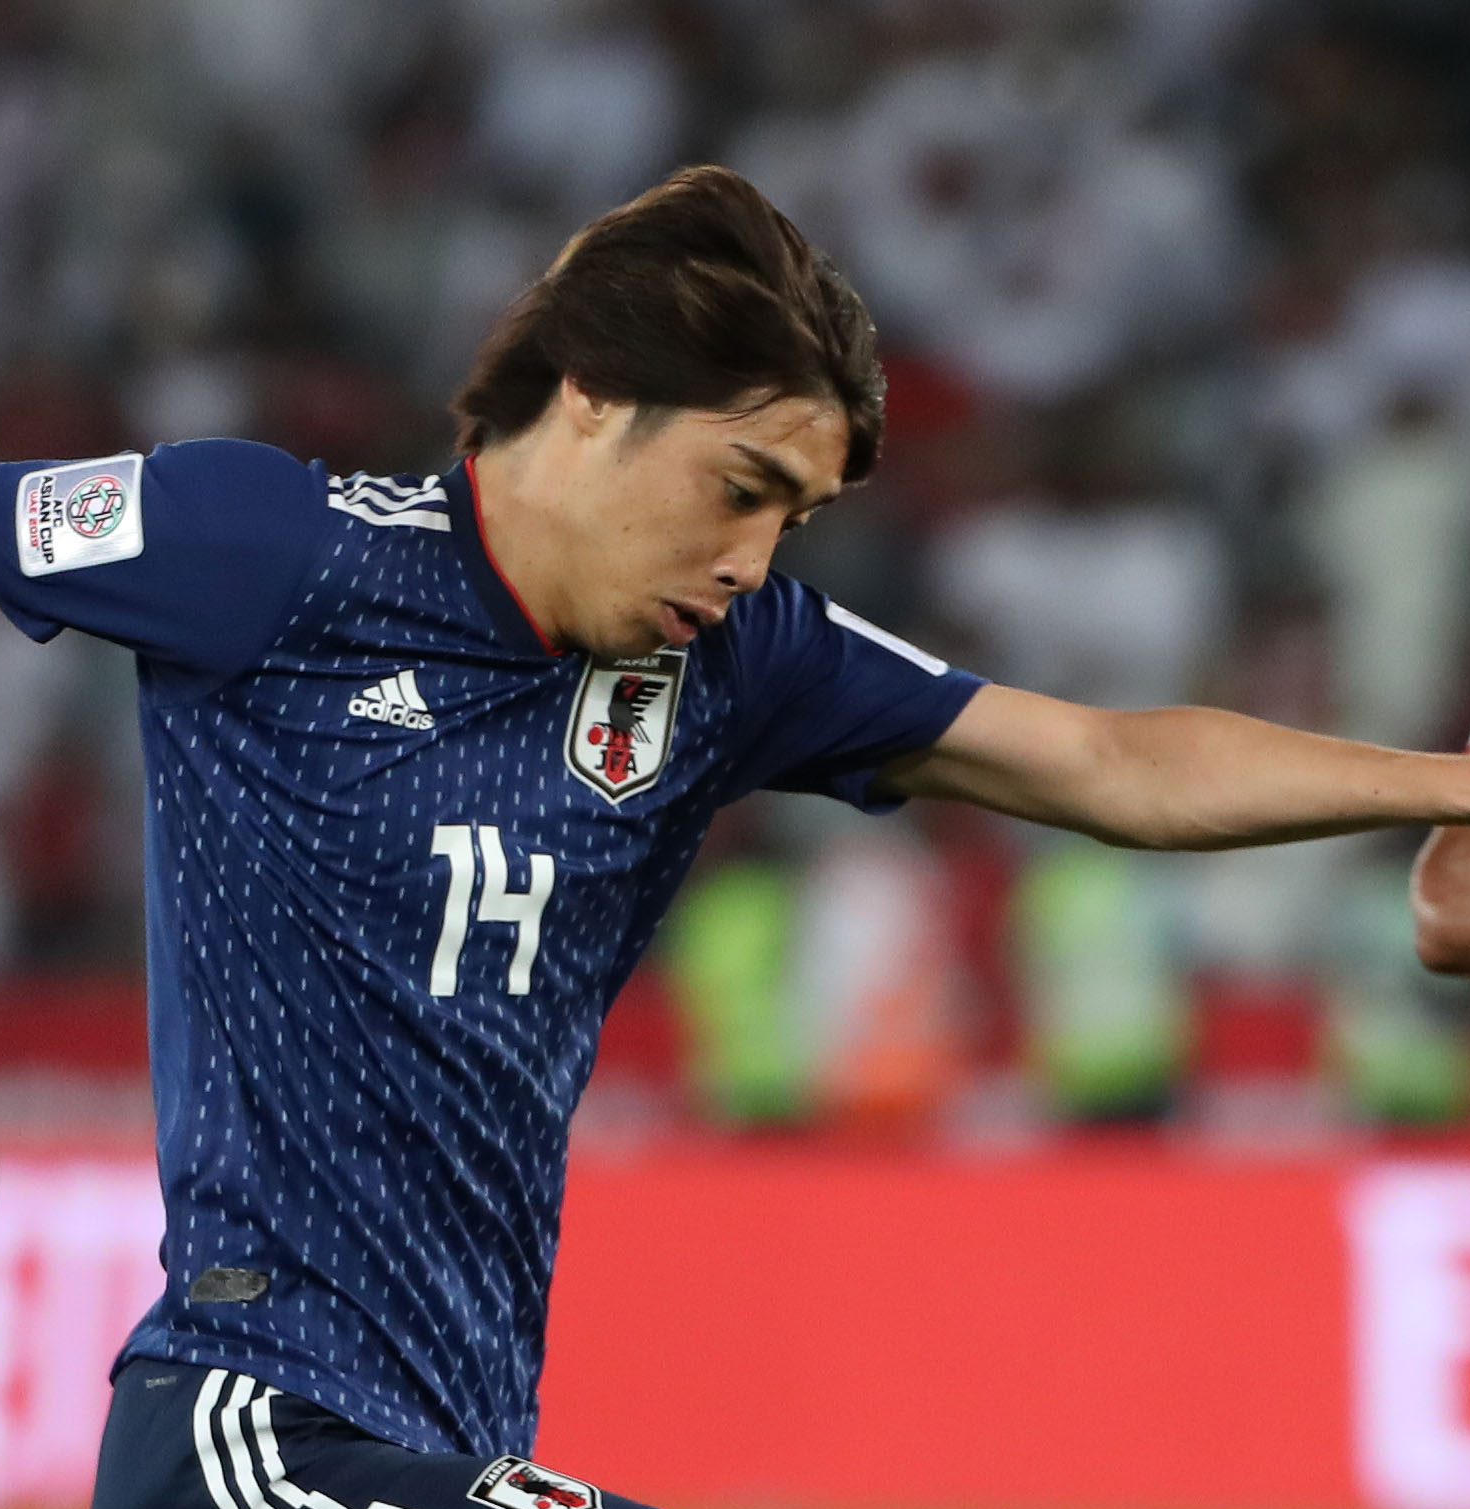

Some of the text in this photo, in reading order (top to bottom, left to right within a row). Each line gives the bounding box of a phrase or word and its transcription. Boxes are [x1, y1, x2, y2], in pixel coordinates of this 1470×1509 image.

[40, 476, 54, 564] ASIAN CUP
[53, 500, 63, 527] AFC
[347, 697, 435, 731] adidas
[594, 750, 638, 775] JFA
[430, 824, 555, 997] 14
